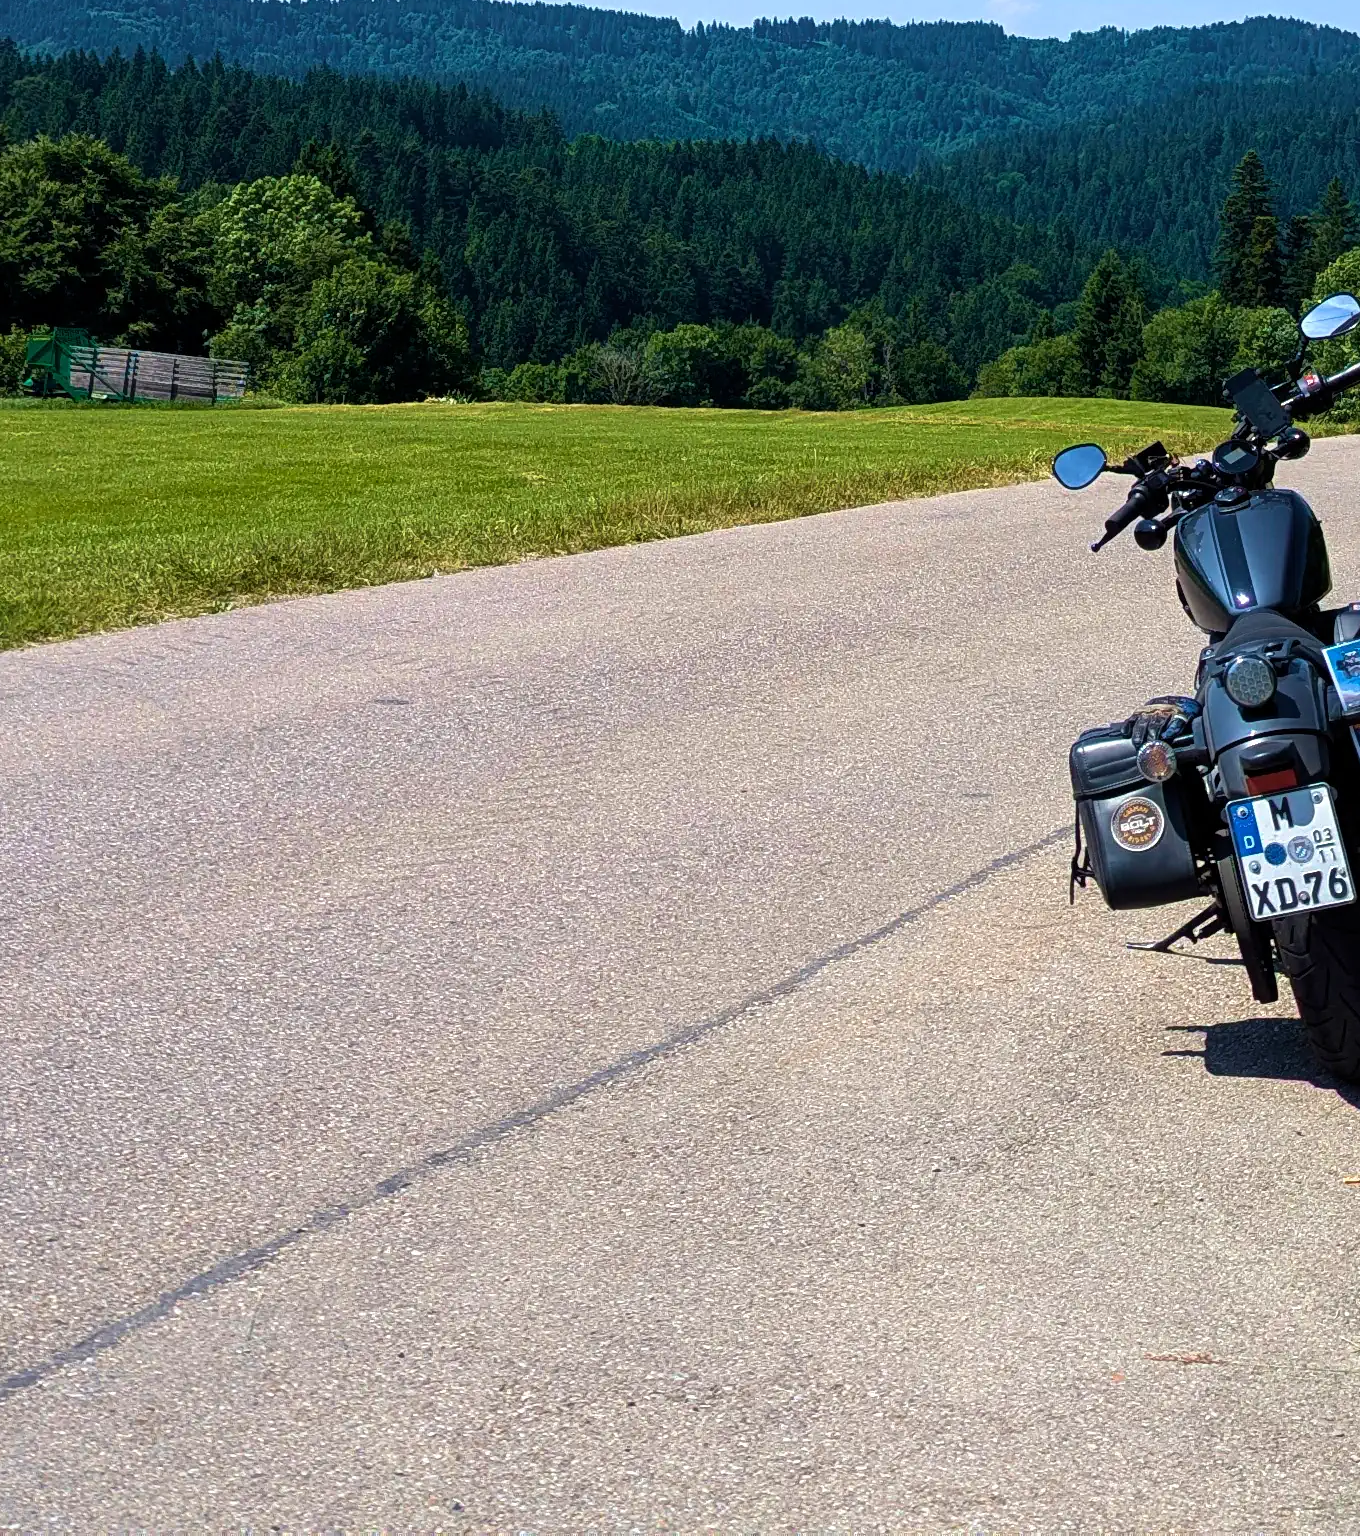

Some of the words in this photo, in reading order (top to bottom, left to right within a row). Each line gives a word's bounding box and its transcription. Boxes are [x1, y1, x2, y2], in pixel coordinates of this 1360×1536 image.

[1268, 796, 1294, 831] M
[1120, 816, 1156, 832] BOLT
[1243, 835, 1256, 850] D
[1312, 827, 1334, 843] 03
[1318, 847, 1338, 863] 11
[1251, 879, 1299, 916] XD
[1303, 867, 1348, 904] 76
